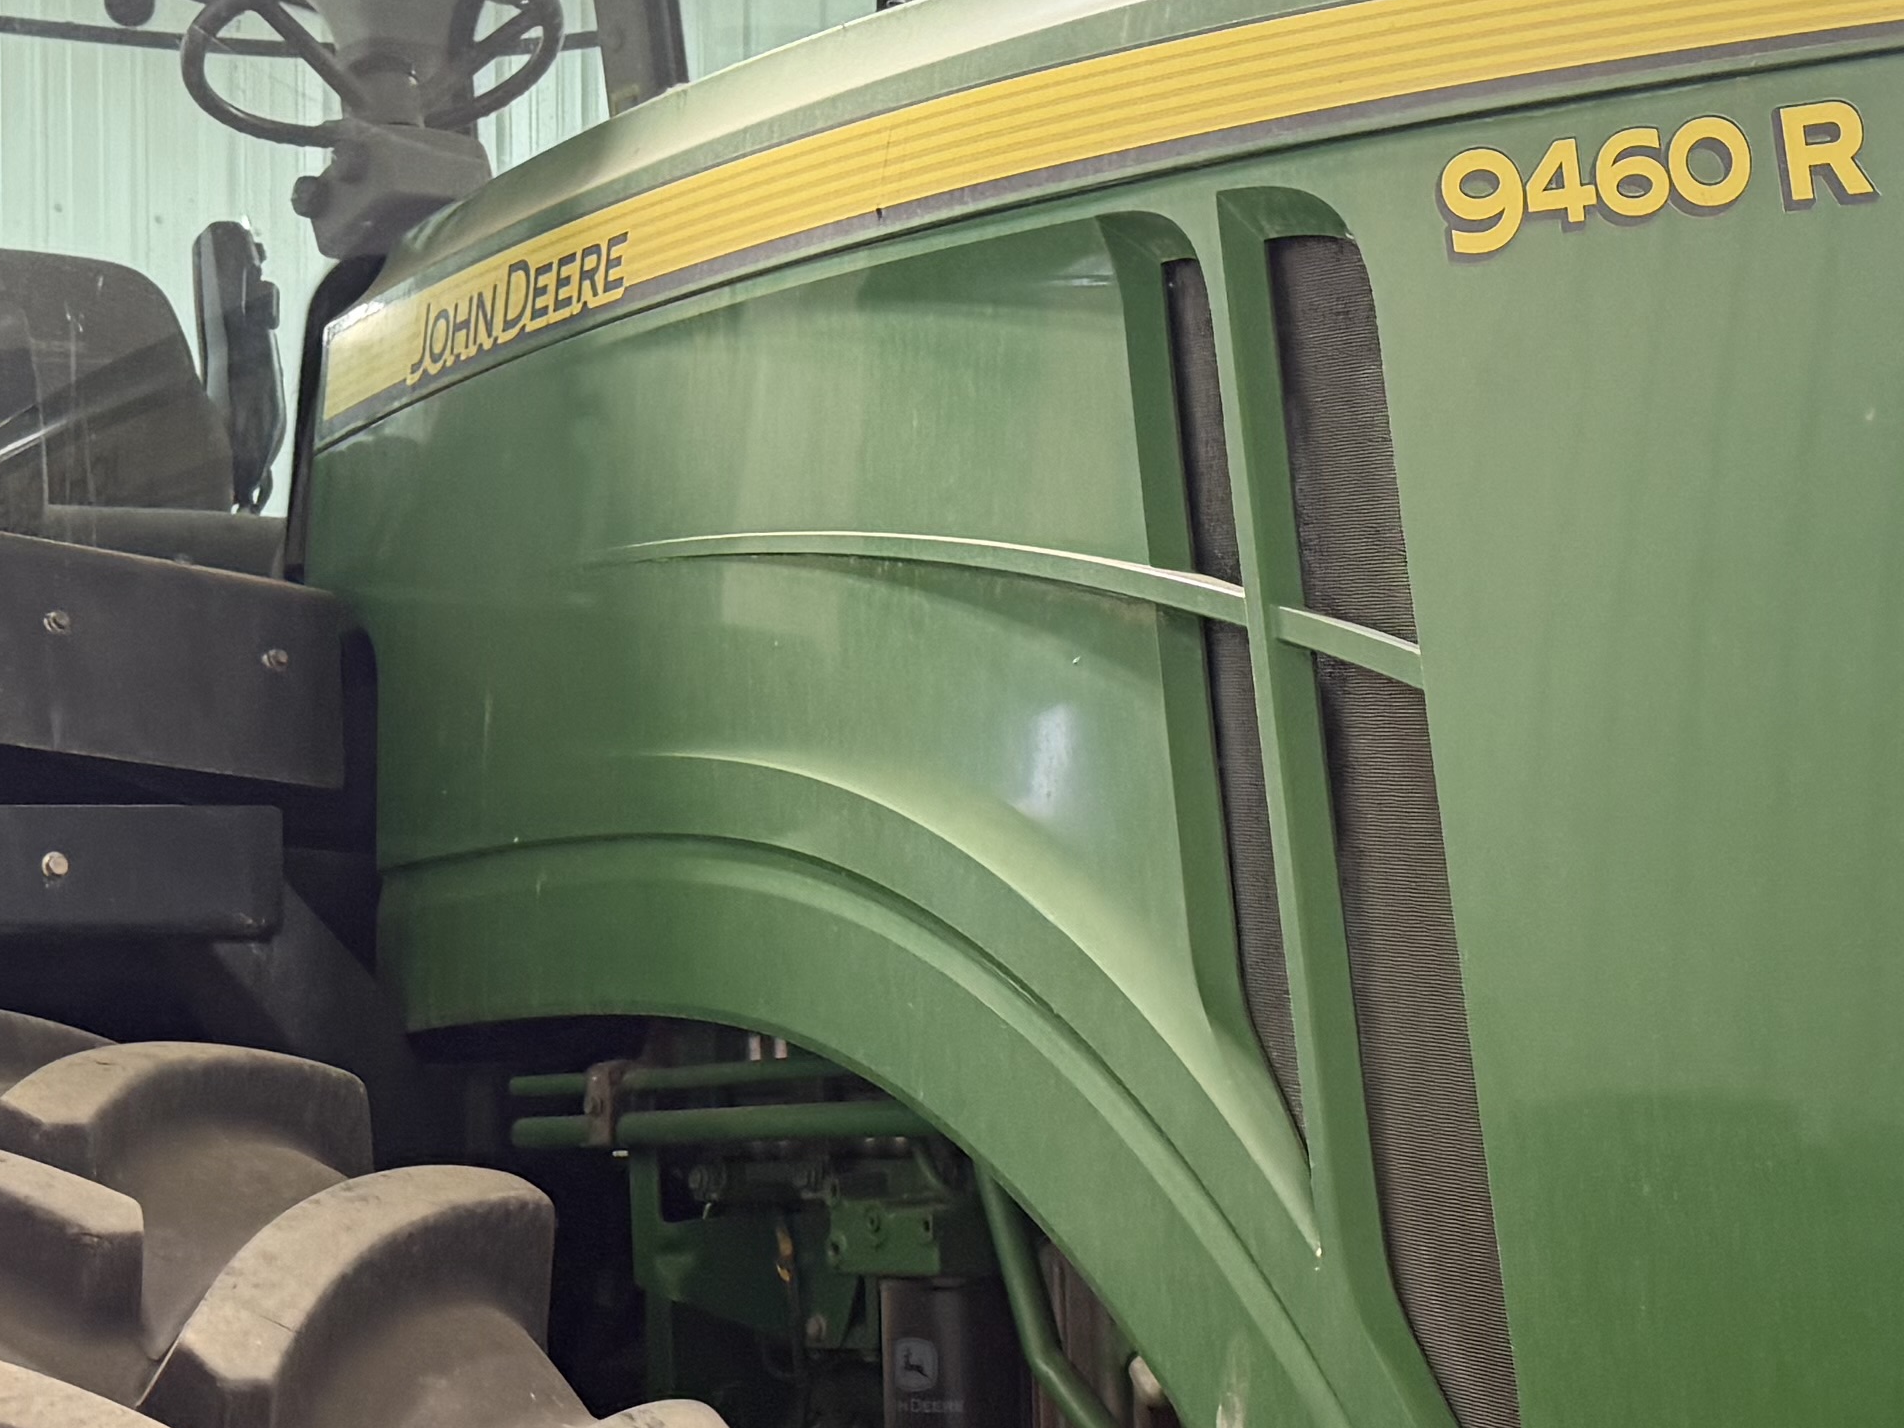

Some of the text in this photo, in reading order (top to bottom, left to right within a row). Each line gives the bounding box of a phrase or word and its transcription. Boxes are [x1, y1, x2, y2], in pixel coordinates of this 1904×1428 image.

[1436, 98, 1880, 261] 9460 R
[409, 231, 629, 375] JOHN DEERE
